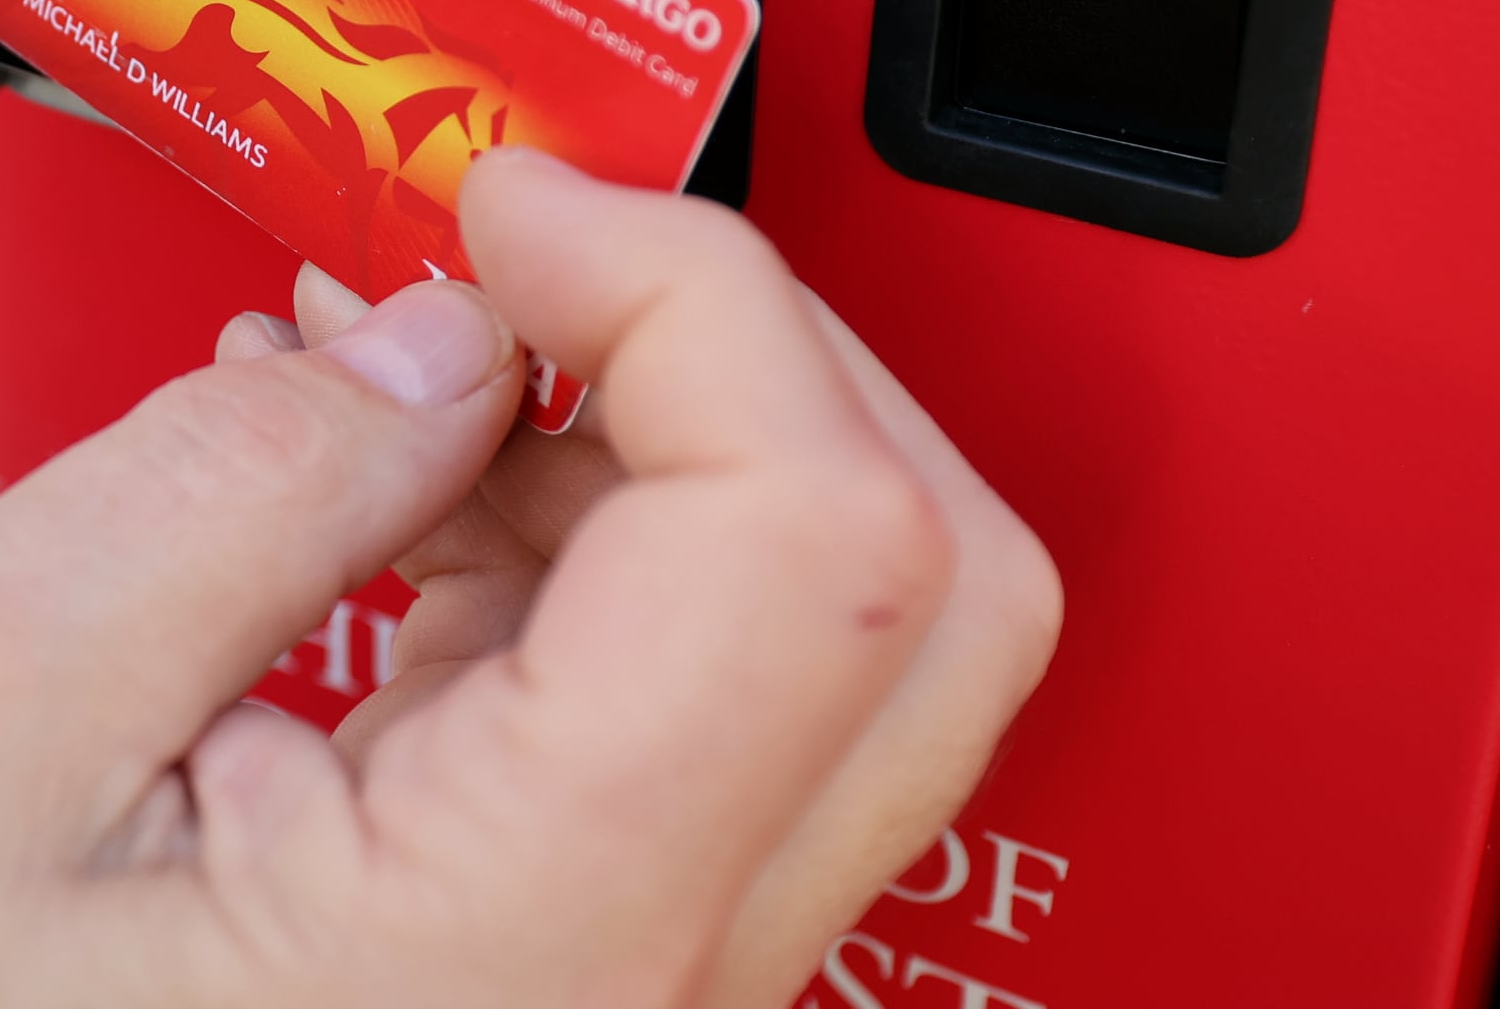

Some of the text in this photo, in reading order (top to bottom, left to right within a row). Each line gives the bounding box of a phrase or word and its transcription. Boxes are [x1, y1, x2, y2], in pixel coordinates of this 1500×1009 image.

[586, 17, 646, 67] Debit
[646, 53, 700, 97] Card
[126, 58, 147, 84] D
[151, 72, 268, 168] WILLIAMS
